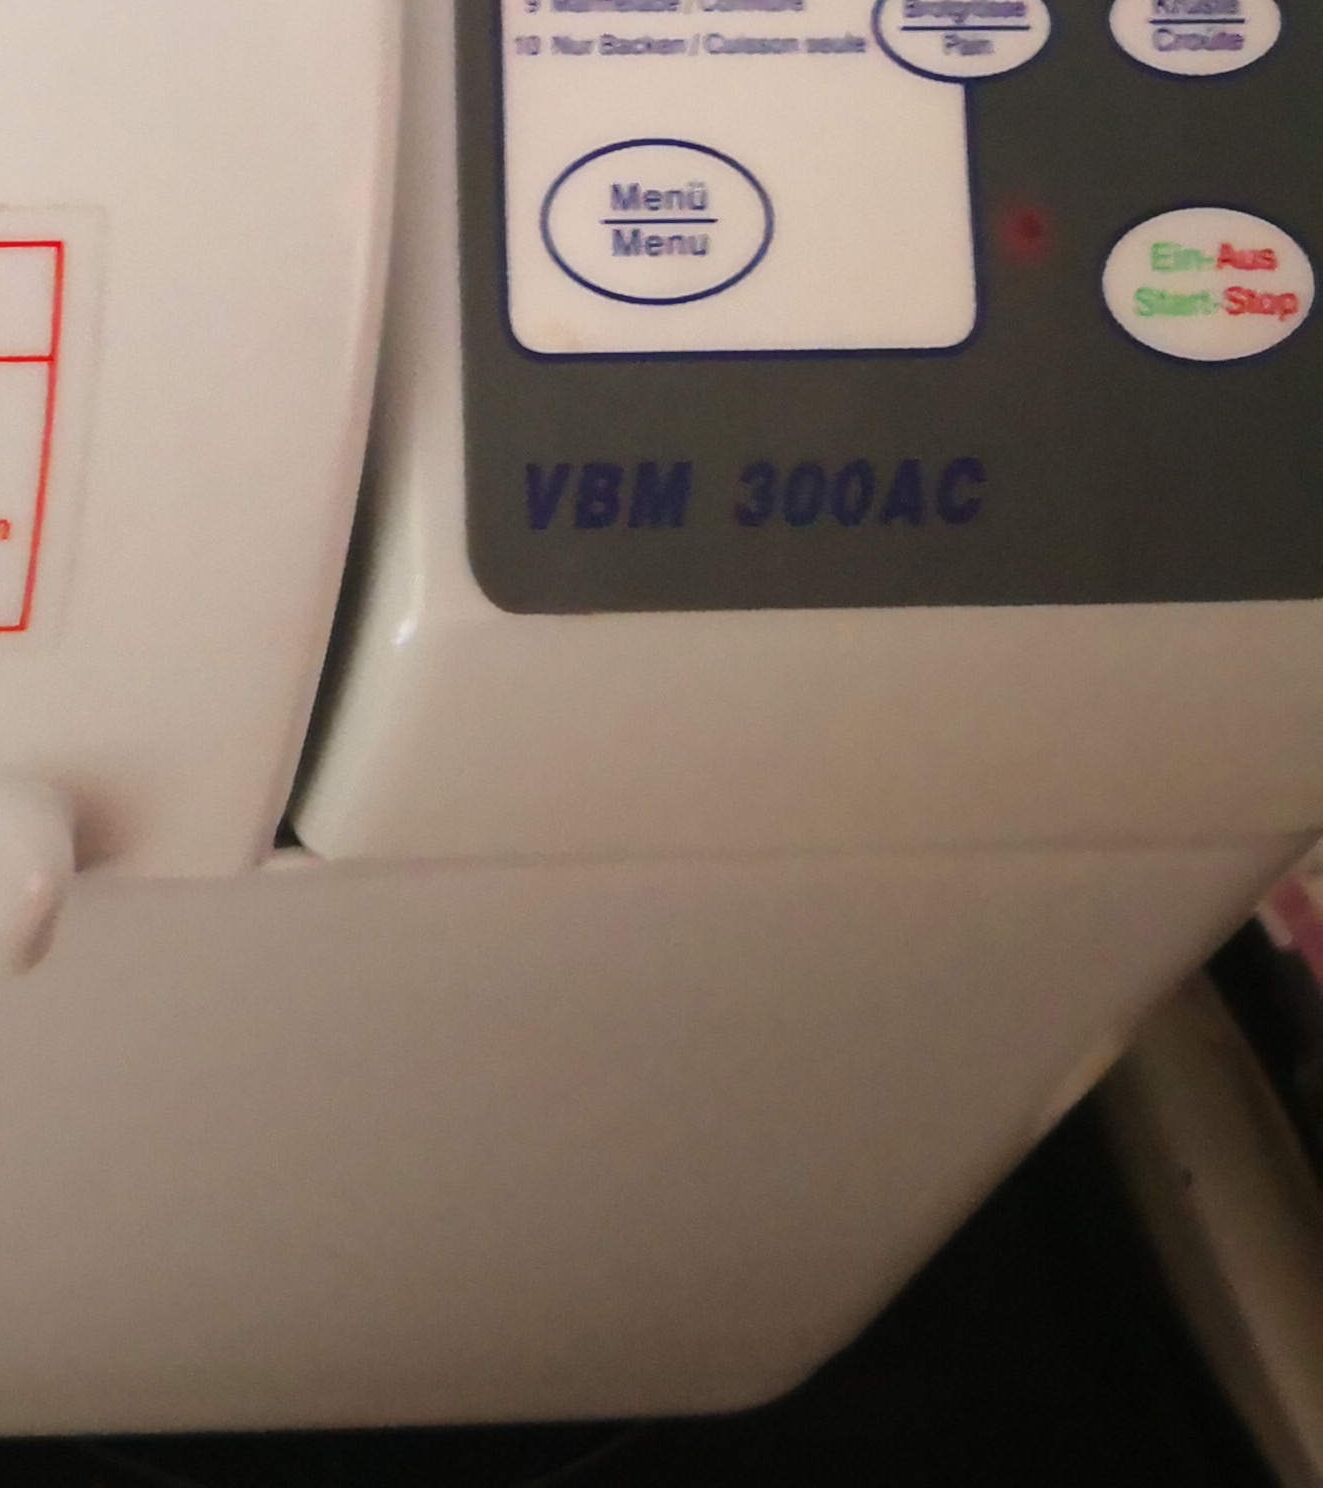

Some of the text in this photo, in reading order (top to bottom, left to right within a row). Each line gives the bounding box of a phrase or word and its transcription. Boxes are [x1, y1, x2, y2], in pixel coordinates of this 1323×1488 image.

[611, 181, 709, 212] Menü
[611, 227, 710, 258] Menu
[525, 455, 989, 530] VBM 300AC
